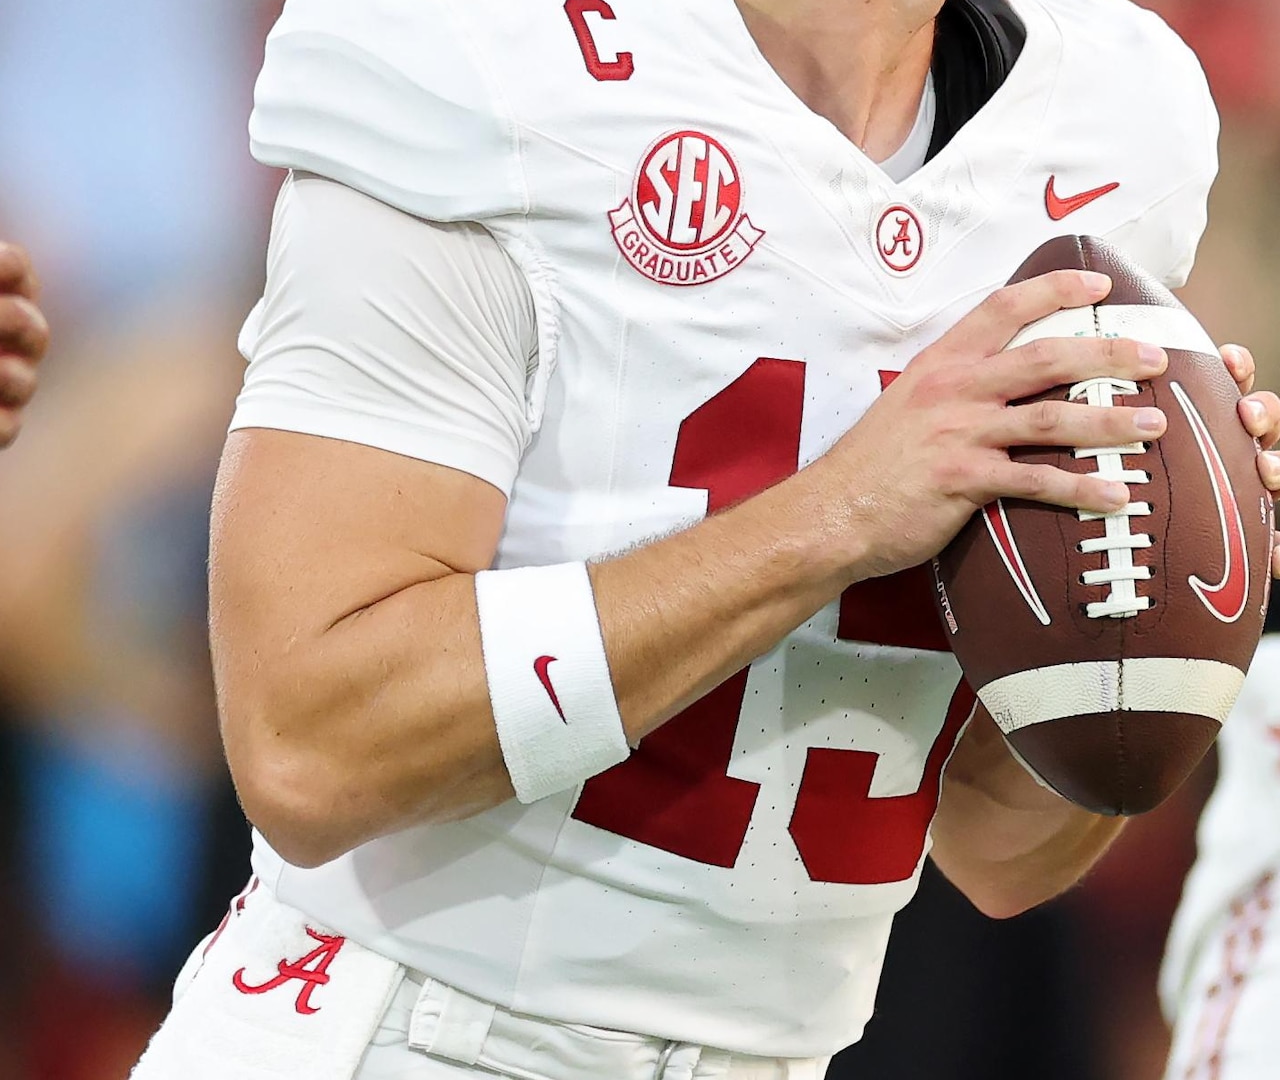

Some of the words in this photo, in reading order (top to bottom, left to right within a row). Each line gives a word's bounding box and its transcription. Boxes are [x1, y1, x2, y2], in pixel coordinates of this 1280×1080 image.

[641, 136, 736, 245] SEC
[622, 230, 738, 281] GRADUATE
[232, 924, 346, 1015] A
